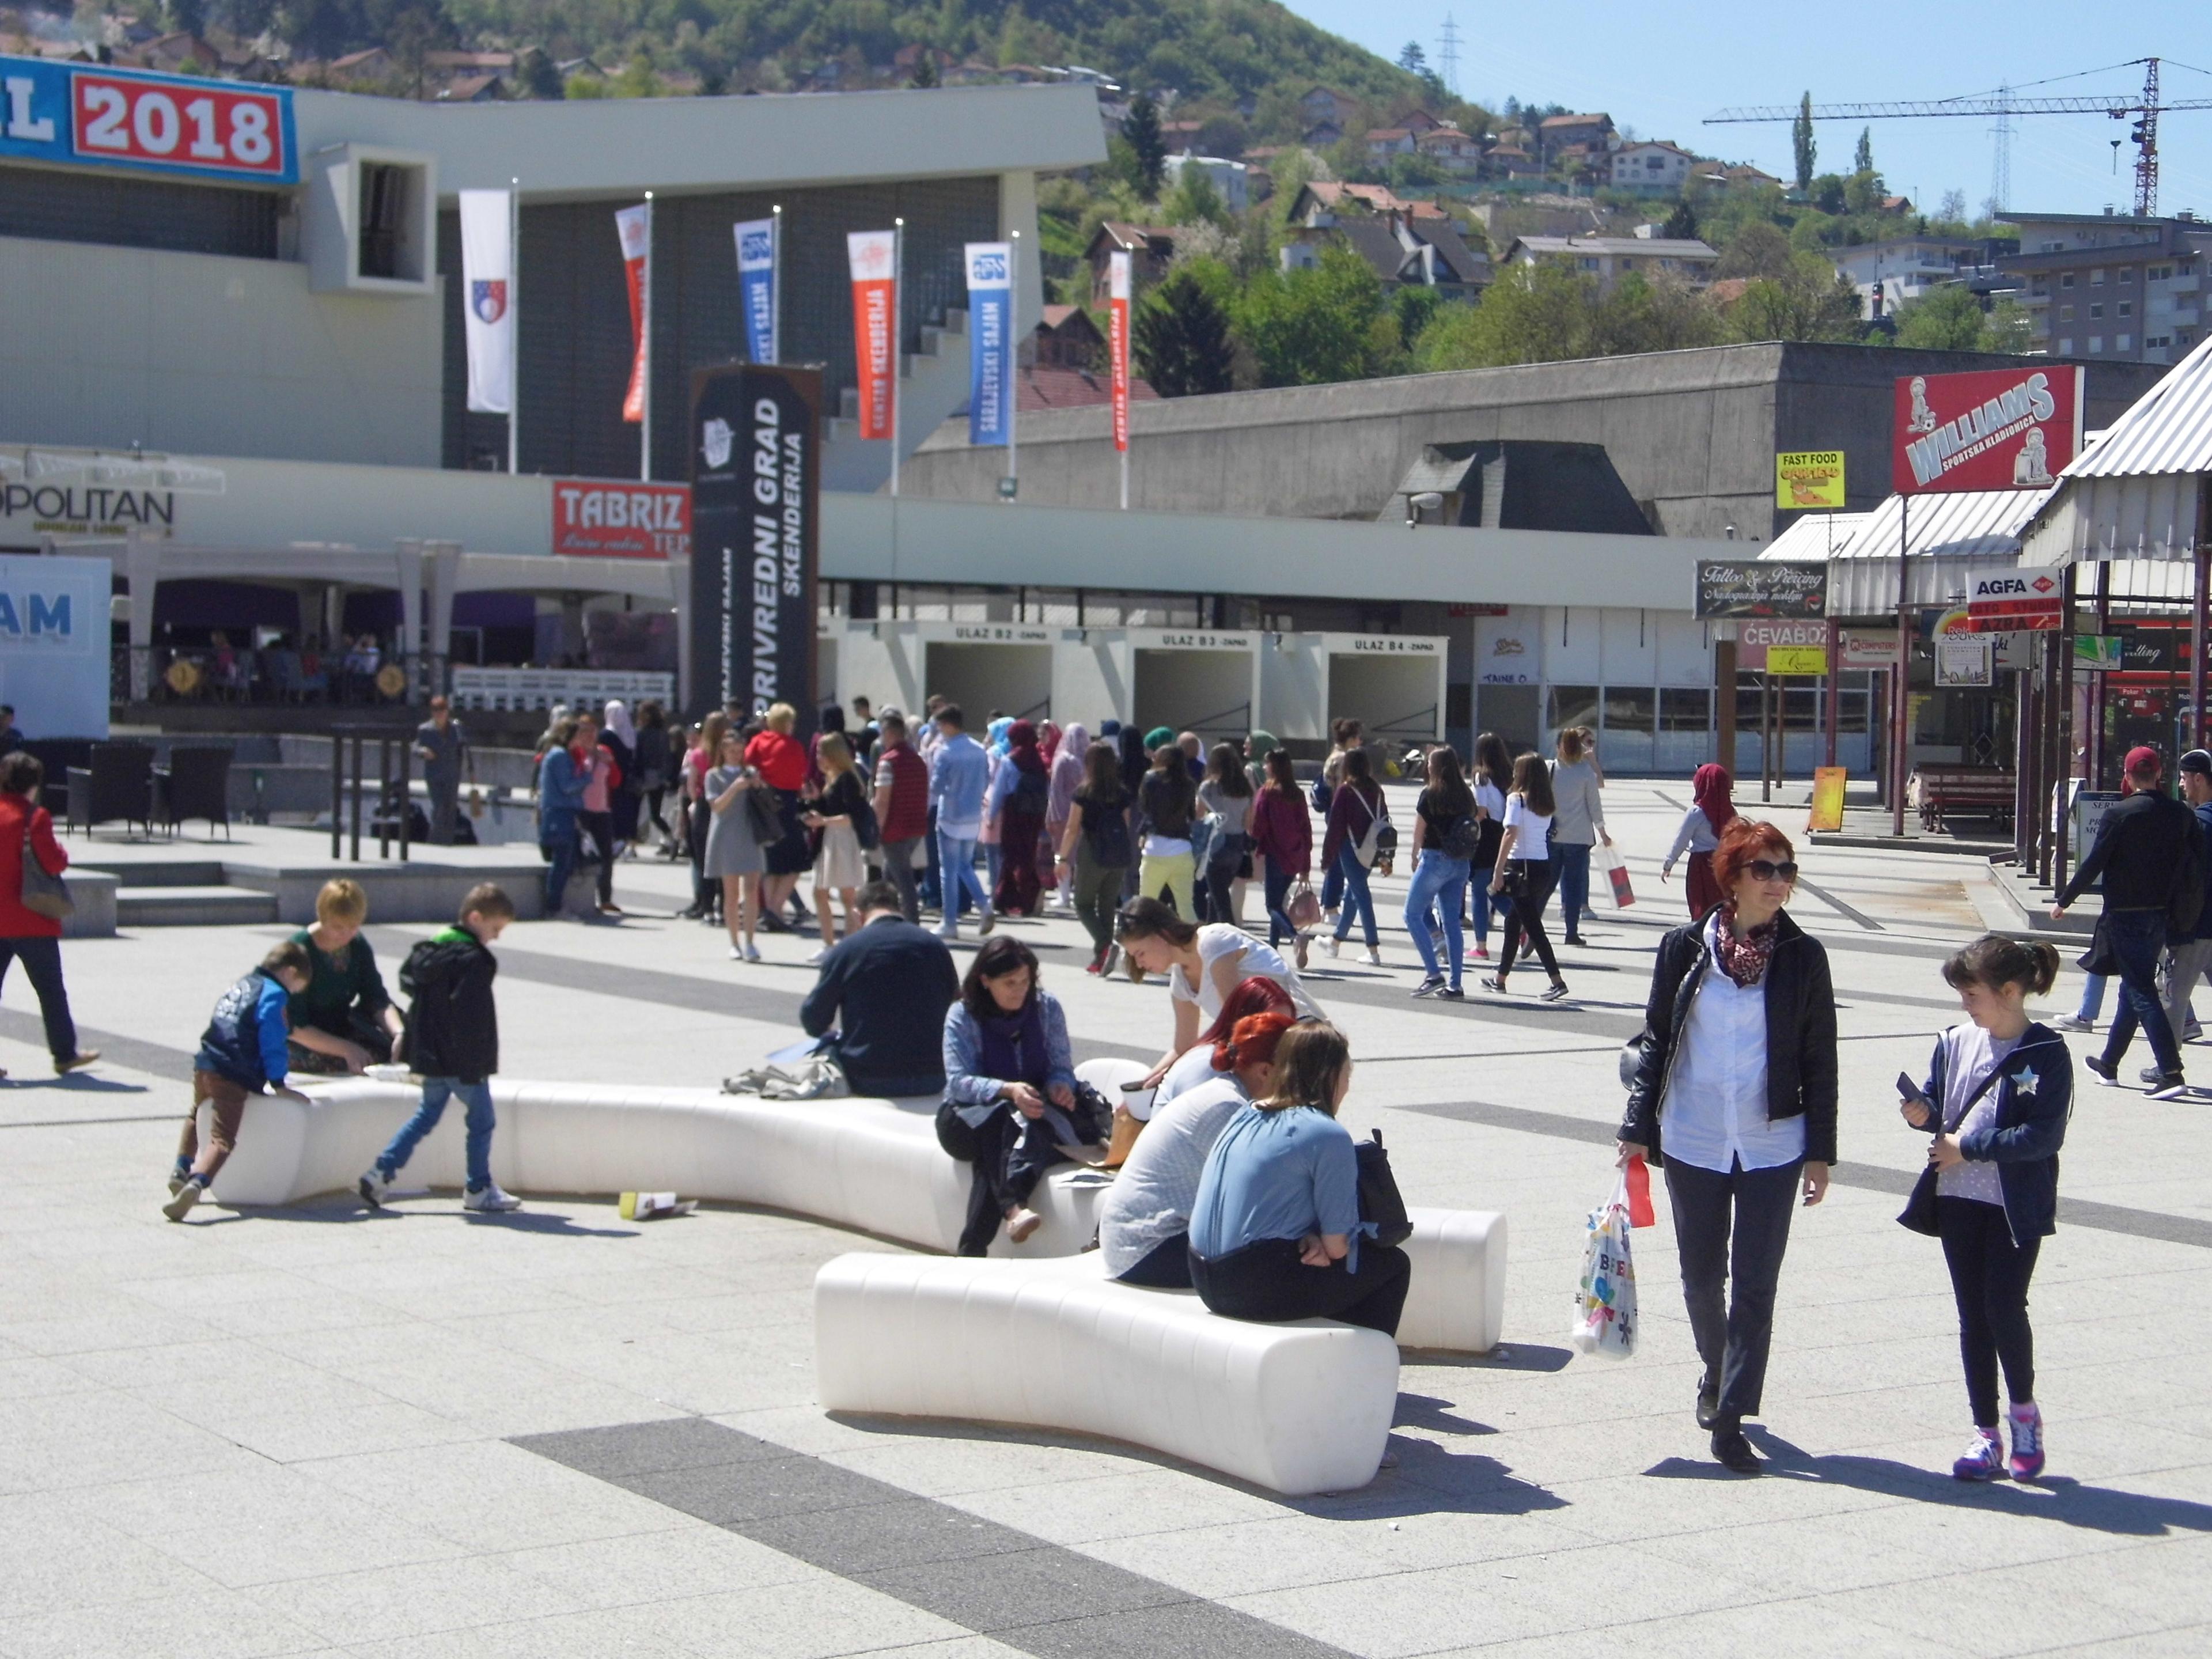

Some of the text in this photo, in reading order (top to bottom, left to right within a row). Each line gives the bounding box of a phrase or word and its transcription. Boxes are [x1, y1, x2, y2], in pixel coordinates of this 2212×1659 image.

[83, 85, 272, 164] 2018
[982, 302, 1000, 347] SAJAM
[1905, 373, 2055, 486] WILLIAMS
[1942, 415, 2035, 471] SPORTSKA KLADIONICA
[1783, 453, 1837, 465] FAST FOOD
[0, 484, 172, 525] POLITAN
[559, 488, 682, 532] TABRIZ
[783, 433, 802, 597] SKENDERIJA
[722, 548, 732, 609] SAJAM
[752, 399, 779, 719] PRIVREDNI GRAD
[1702, 566, 1823, 589] Tattoo & Piercing
[1977, 579, 2027, 594] AGFA
[2013, 598, 2059, 612] STUDIO
[956, 627, 989, 639] ULAZ
[1162, 635, 1194, 646] ULAZ
[1978, 616, 2029, 632] AZRA
[1355, 641, 1384, 650] ULAZ
